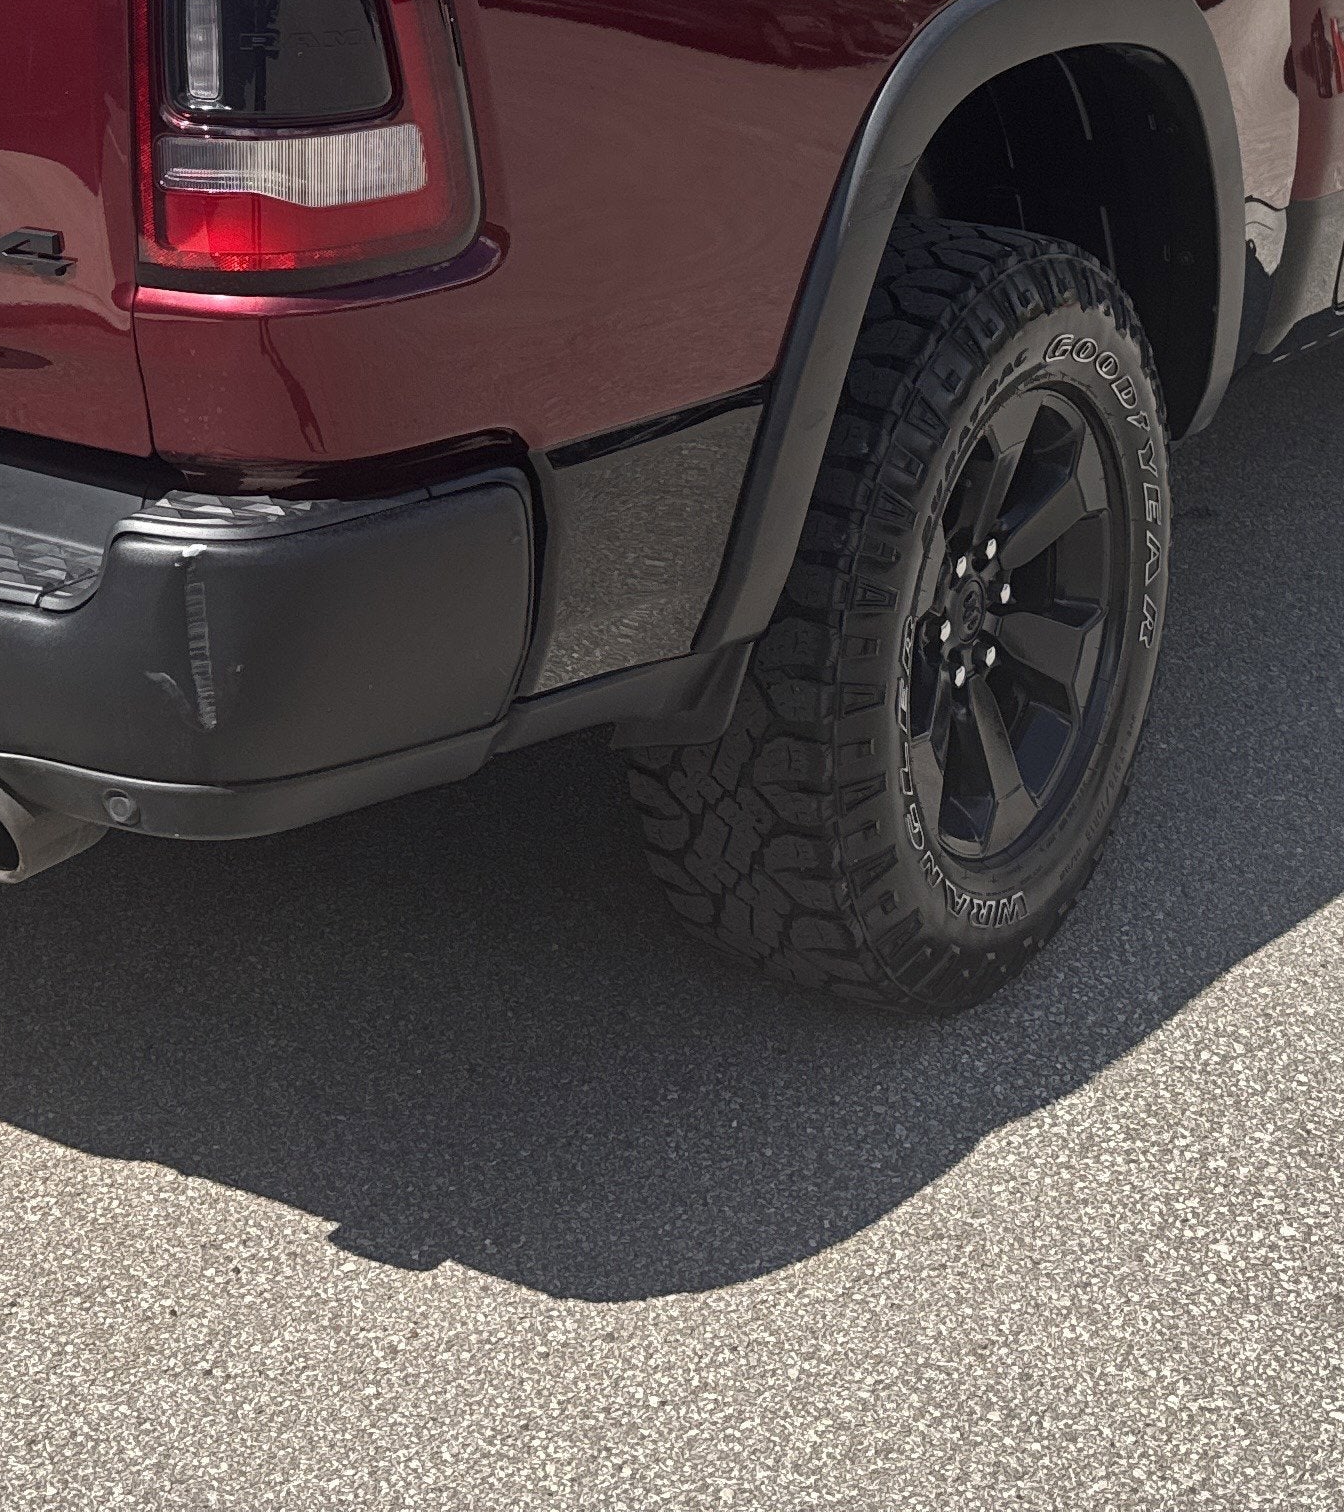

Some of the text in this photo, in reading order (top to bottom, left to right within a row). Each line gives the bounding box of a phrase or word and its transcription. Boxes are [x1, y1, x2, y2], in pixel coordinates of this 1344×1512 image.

[240, 28, 365, 51] RAM
[1043, 334, 1162, 649] GOODYEAR
[896, 614, 1030, 929] WRANGLER
